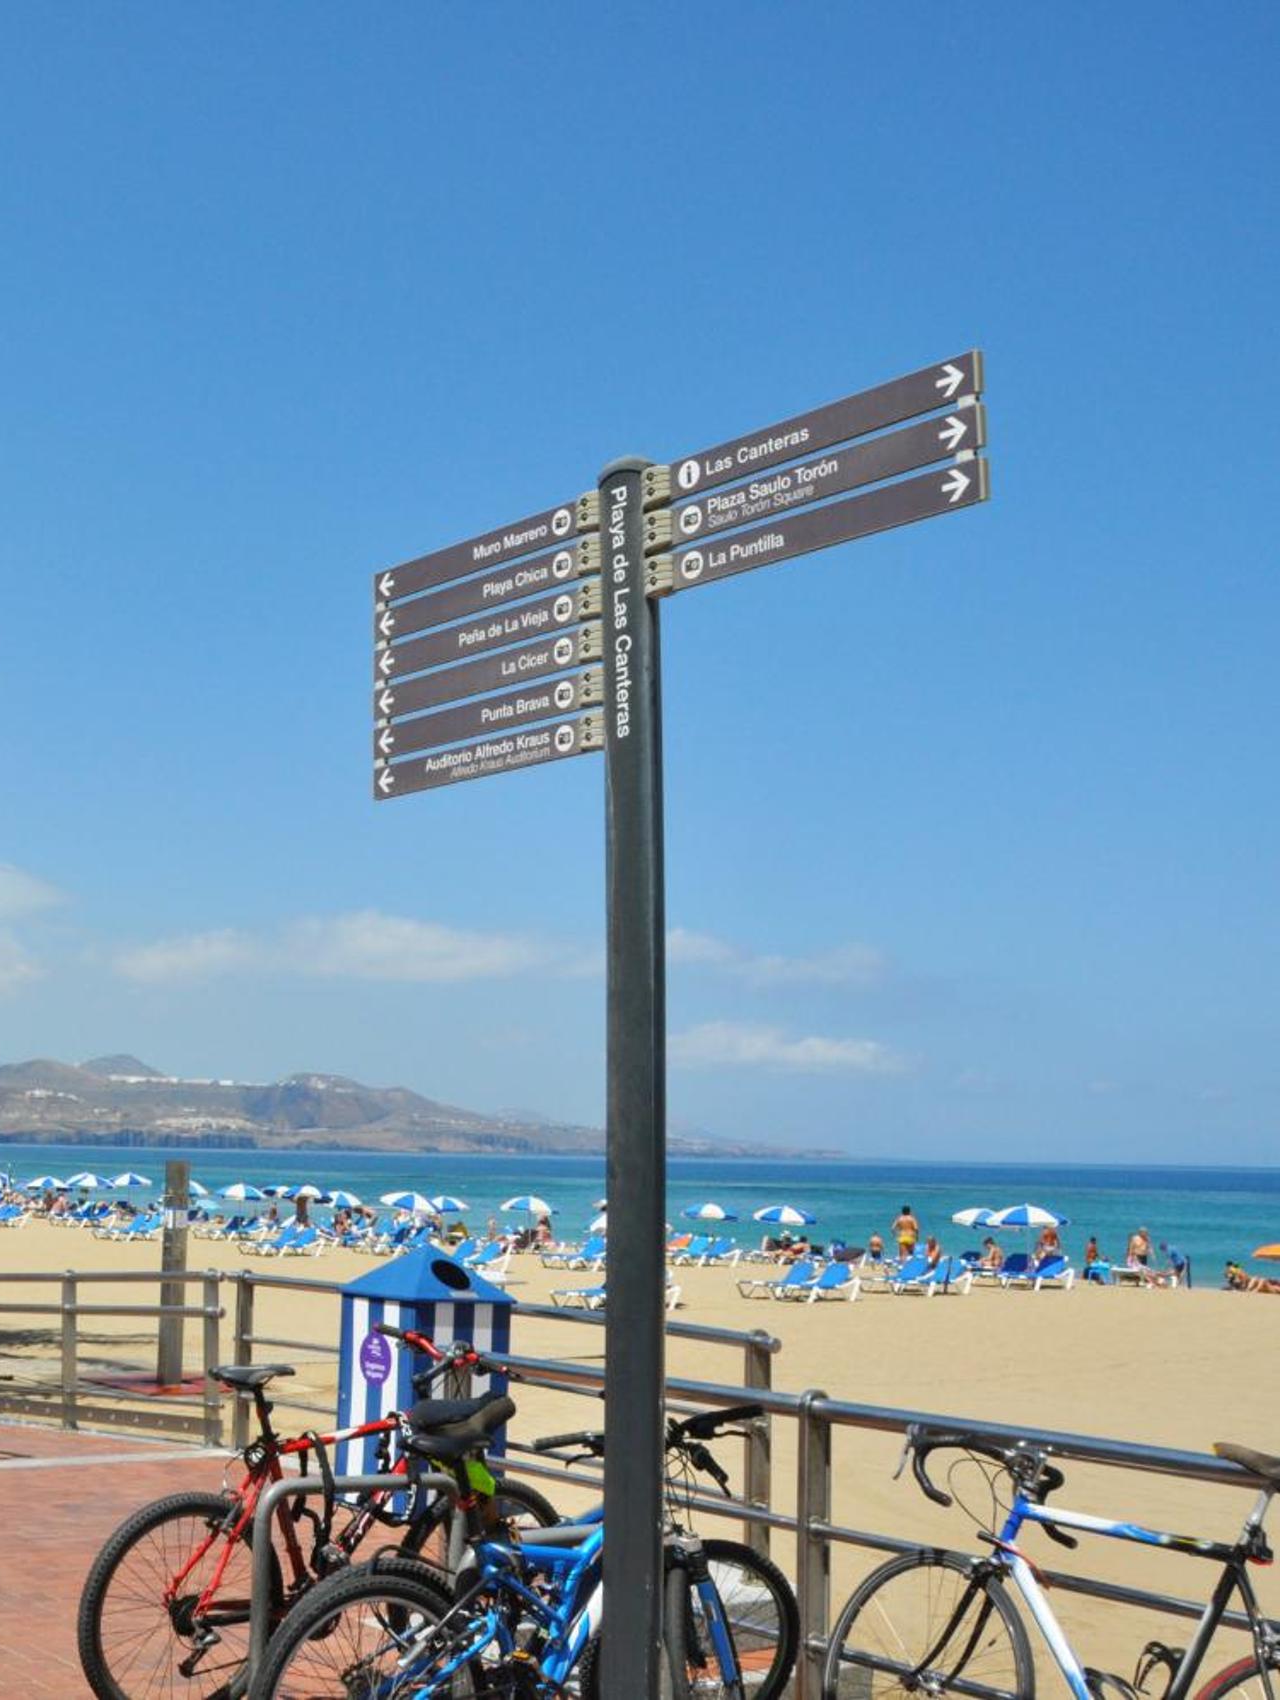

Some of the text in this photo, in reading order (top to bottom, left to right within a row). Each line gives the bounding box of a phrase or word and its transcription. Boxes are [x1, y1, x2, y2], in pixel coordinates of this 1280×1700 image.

[705, 427, 810, 476] Las Canteras
[707, 459, 838, 514] Plaza Saulo Torón
[473, 524, 548, 561] Muro Marrero
[709, 533, 785, 568] La Puntilla
[482, 566, 549, 598] Playa Chica
[458, 609, 549, 648] Peña de La Vieja
[609, 485, 633, 738] Playa de Las Canteras
[501, 661, 517, 675] La
[481, 696, 550, 723] Punta Brava
[426, 731, 551, 772] Auditorio Alfredo Kraus
